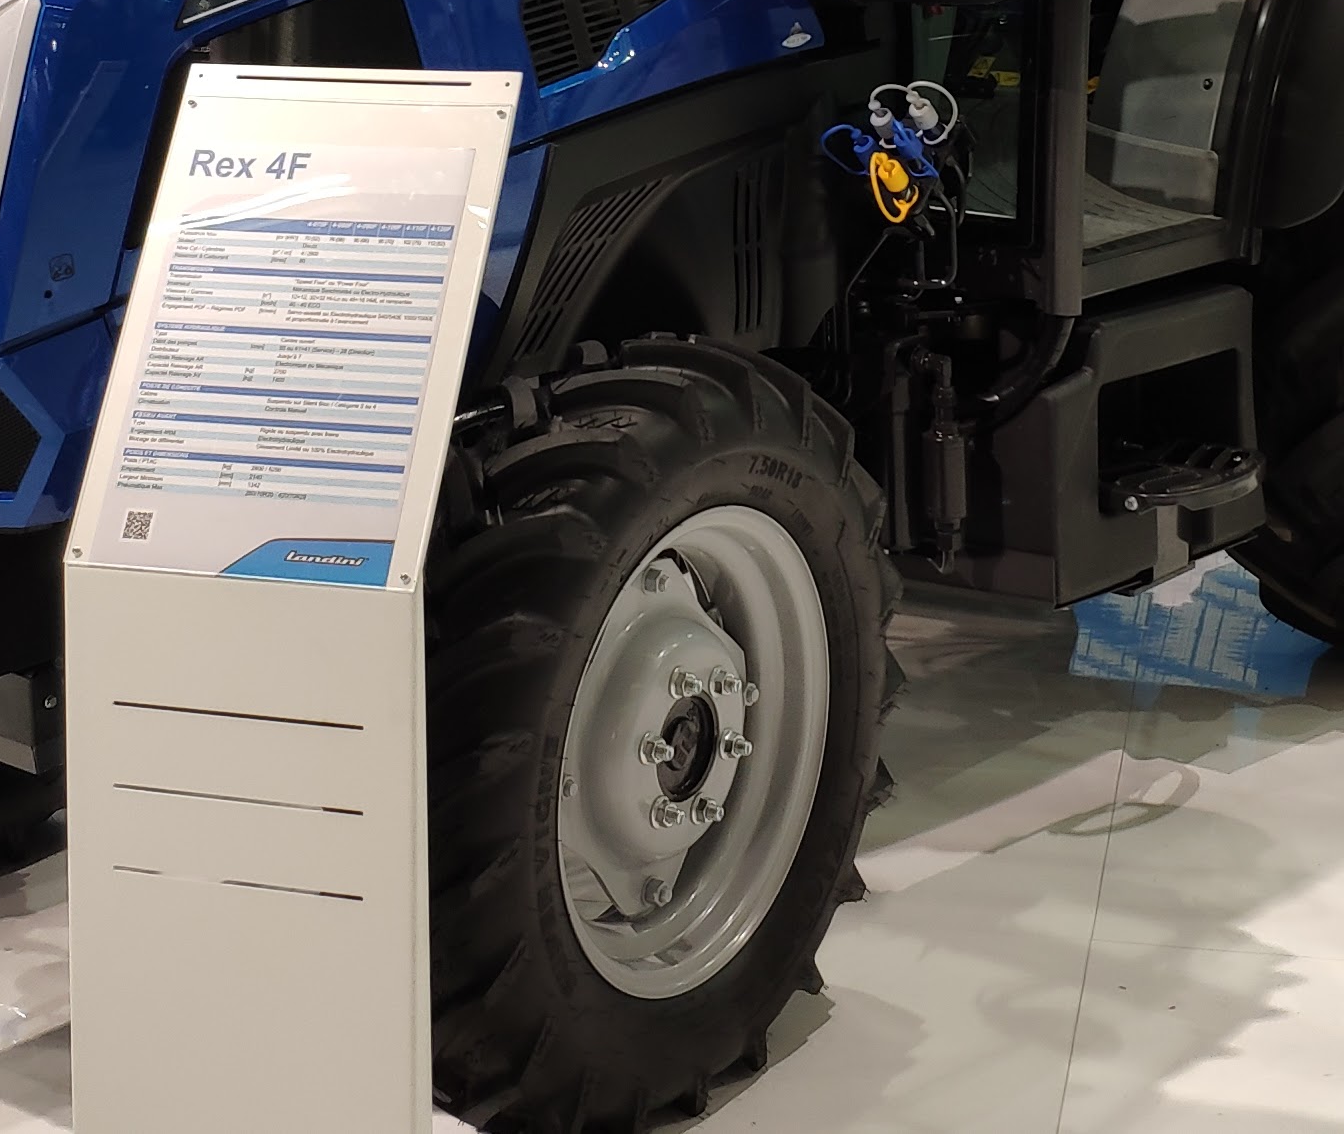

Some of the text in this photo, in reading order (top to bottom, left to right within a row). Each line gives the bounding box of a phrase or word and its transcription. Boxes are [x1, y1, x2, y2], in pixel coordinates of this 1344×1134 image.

[188, 148, 313, 181] Rex 4F
[747, 454, 804, 490] 7.50R18
[284, 549, 366, 567] Landini
